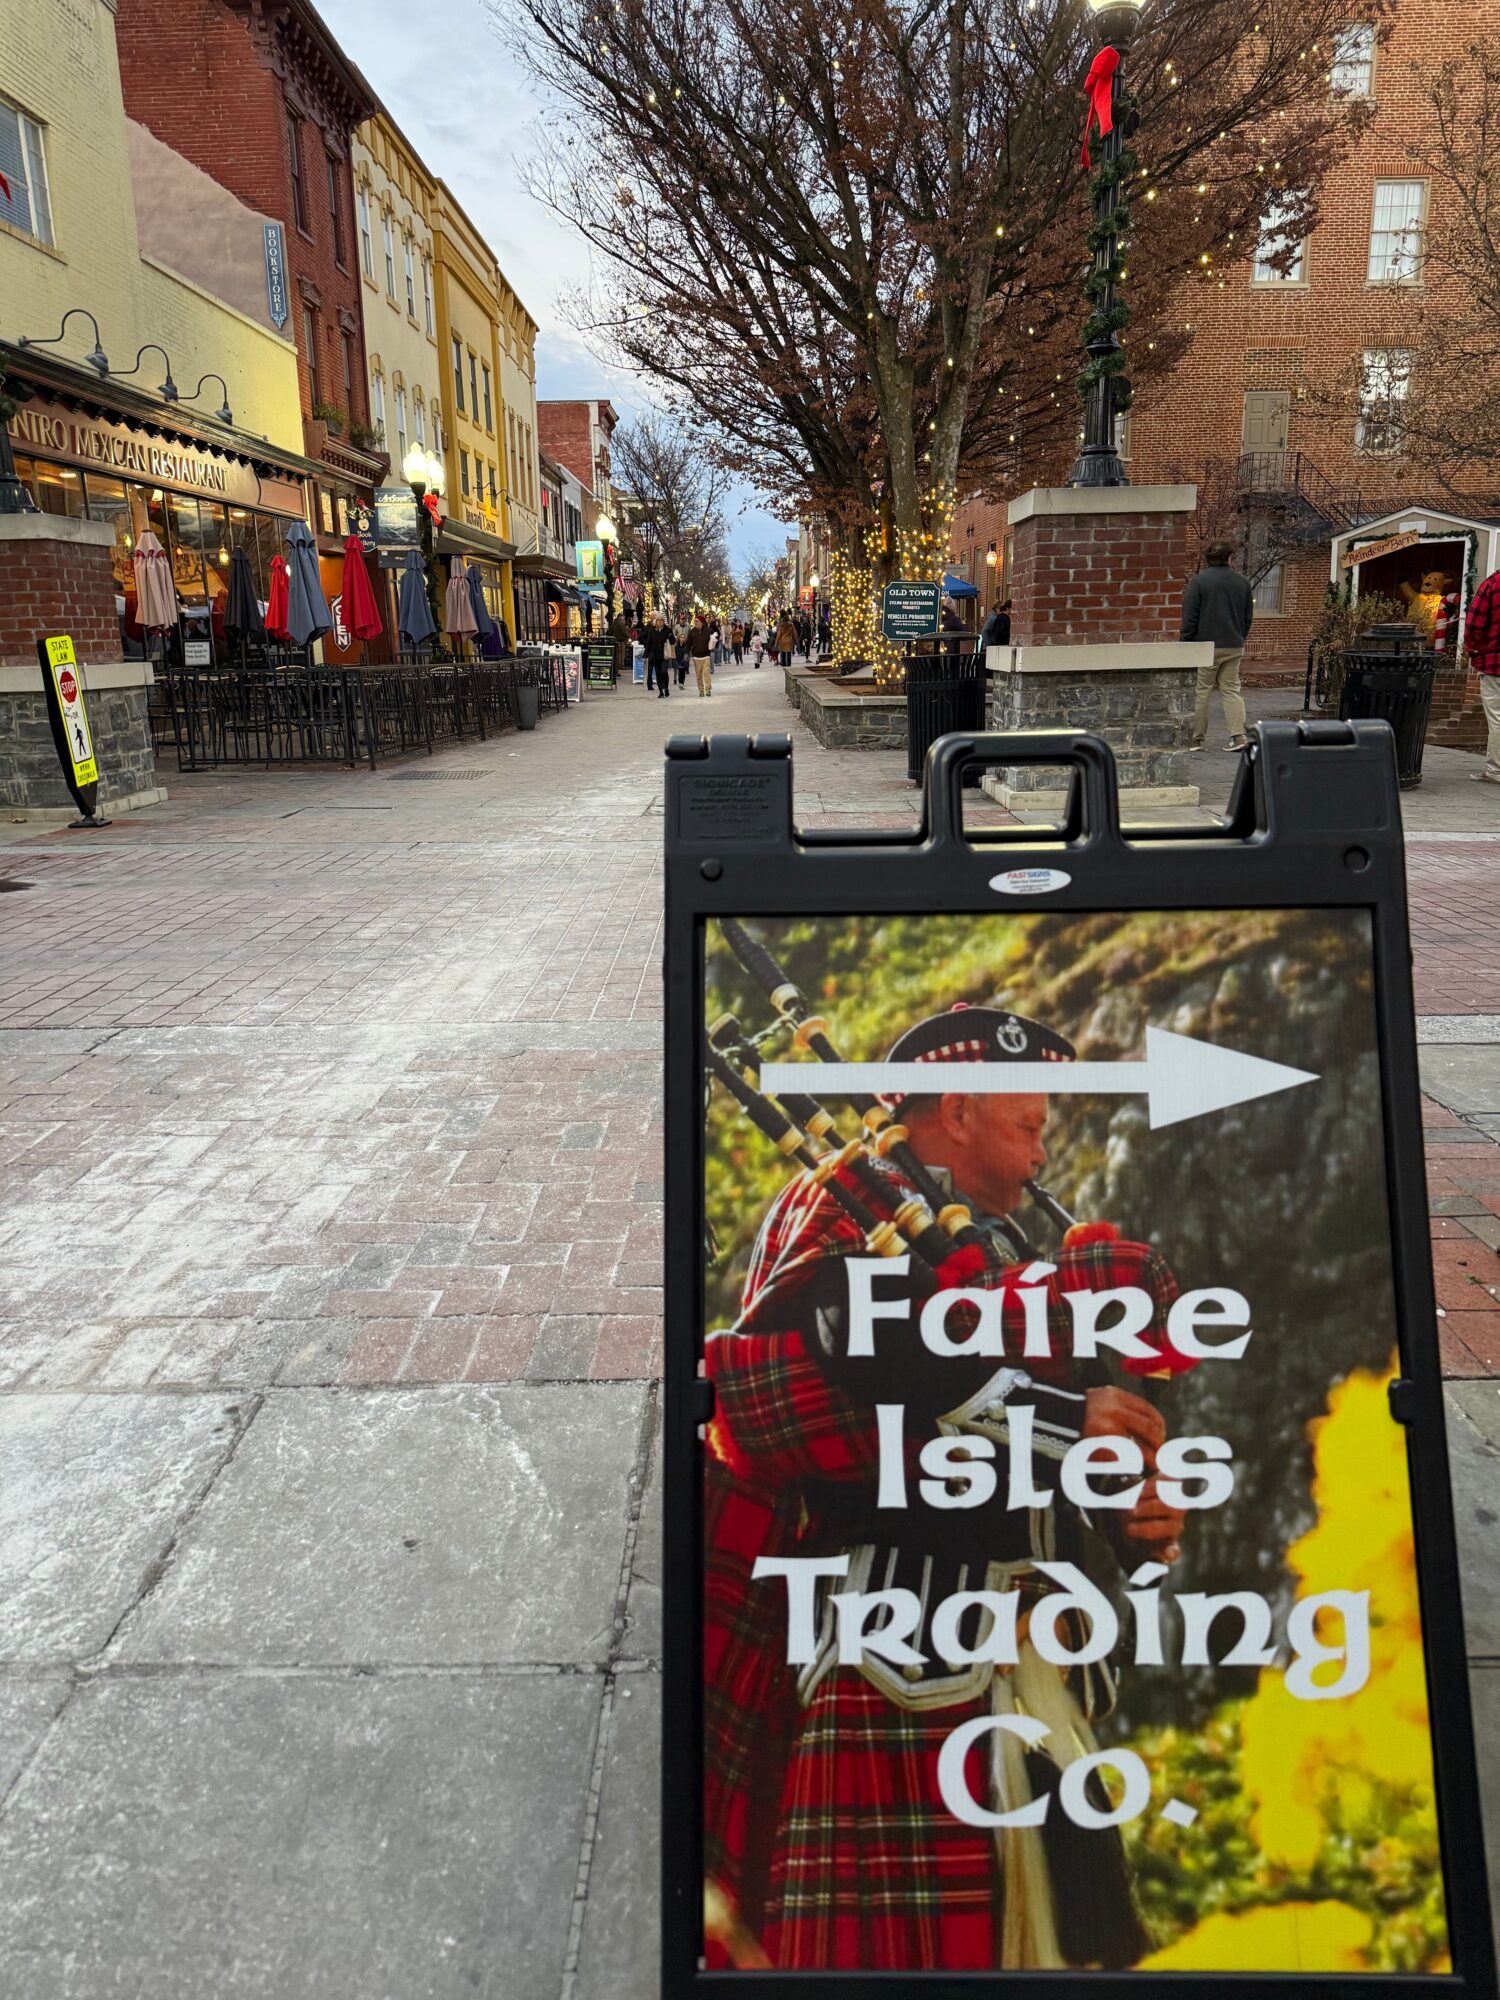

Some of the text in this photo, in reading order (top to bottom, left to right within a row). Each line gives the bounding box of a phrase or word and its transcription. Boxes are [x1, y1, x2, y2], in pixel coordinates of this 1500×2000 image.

[268, 229, 282, 312] BOOKSTORE
[75, 425, 146, 471] MEXICAN
[151, 448, 229, 491] RESTAURANT
[1348, 535, 1415, 564] Reindeer Barn
[51, 640, 69, 651] STATE
[56, 652, 68, 662] LAW
[61, 681, 77, 694] STOP
[845, 1255, 1253, 1359] Faire
[876, 1404, 1235, 1511] Isles
[751, 1554, 1372, 1700] Trading
[937, 1713, 1199, 1829] Co.
